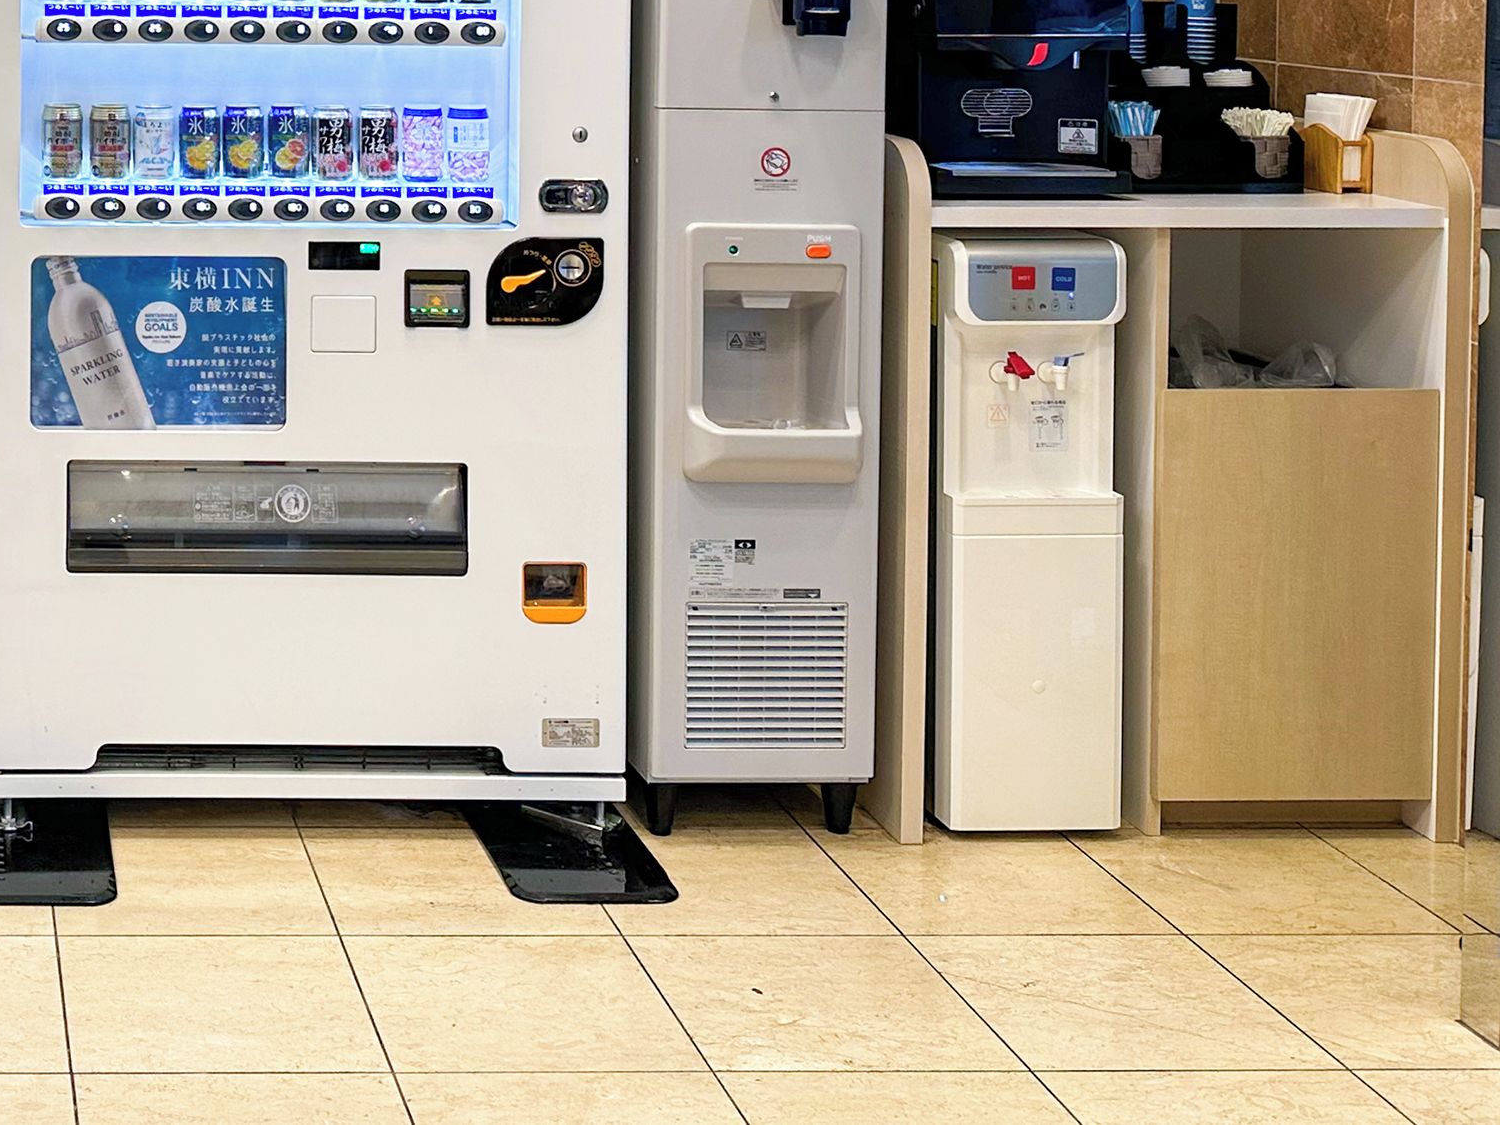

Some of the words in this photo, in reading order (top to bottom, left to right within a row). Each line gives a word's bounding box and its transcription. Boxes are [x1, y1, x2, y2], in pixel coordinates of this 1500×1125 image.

[318, 126, 328, 154] サワー
[327, 118, 345, 154] 男梅
[361, 126, 370, 154] サワー
[369, 118, 389, 154] 男梅
[807, 234, 832, 243] PUSH
[168, 266, 275, 291] 東横INN
[189, 297, 275, 313] 炭酸水誕生
[144, 322, 178, 332] GOALS
[70, 349, 124, 377] SPARKLING
[82, 365, 121, 386] WATER
